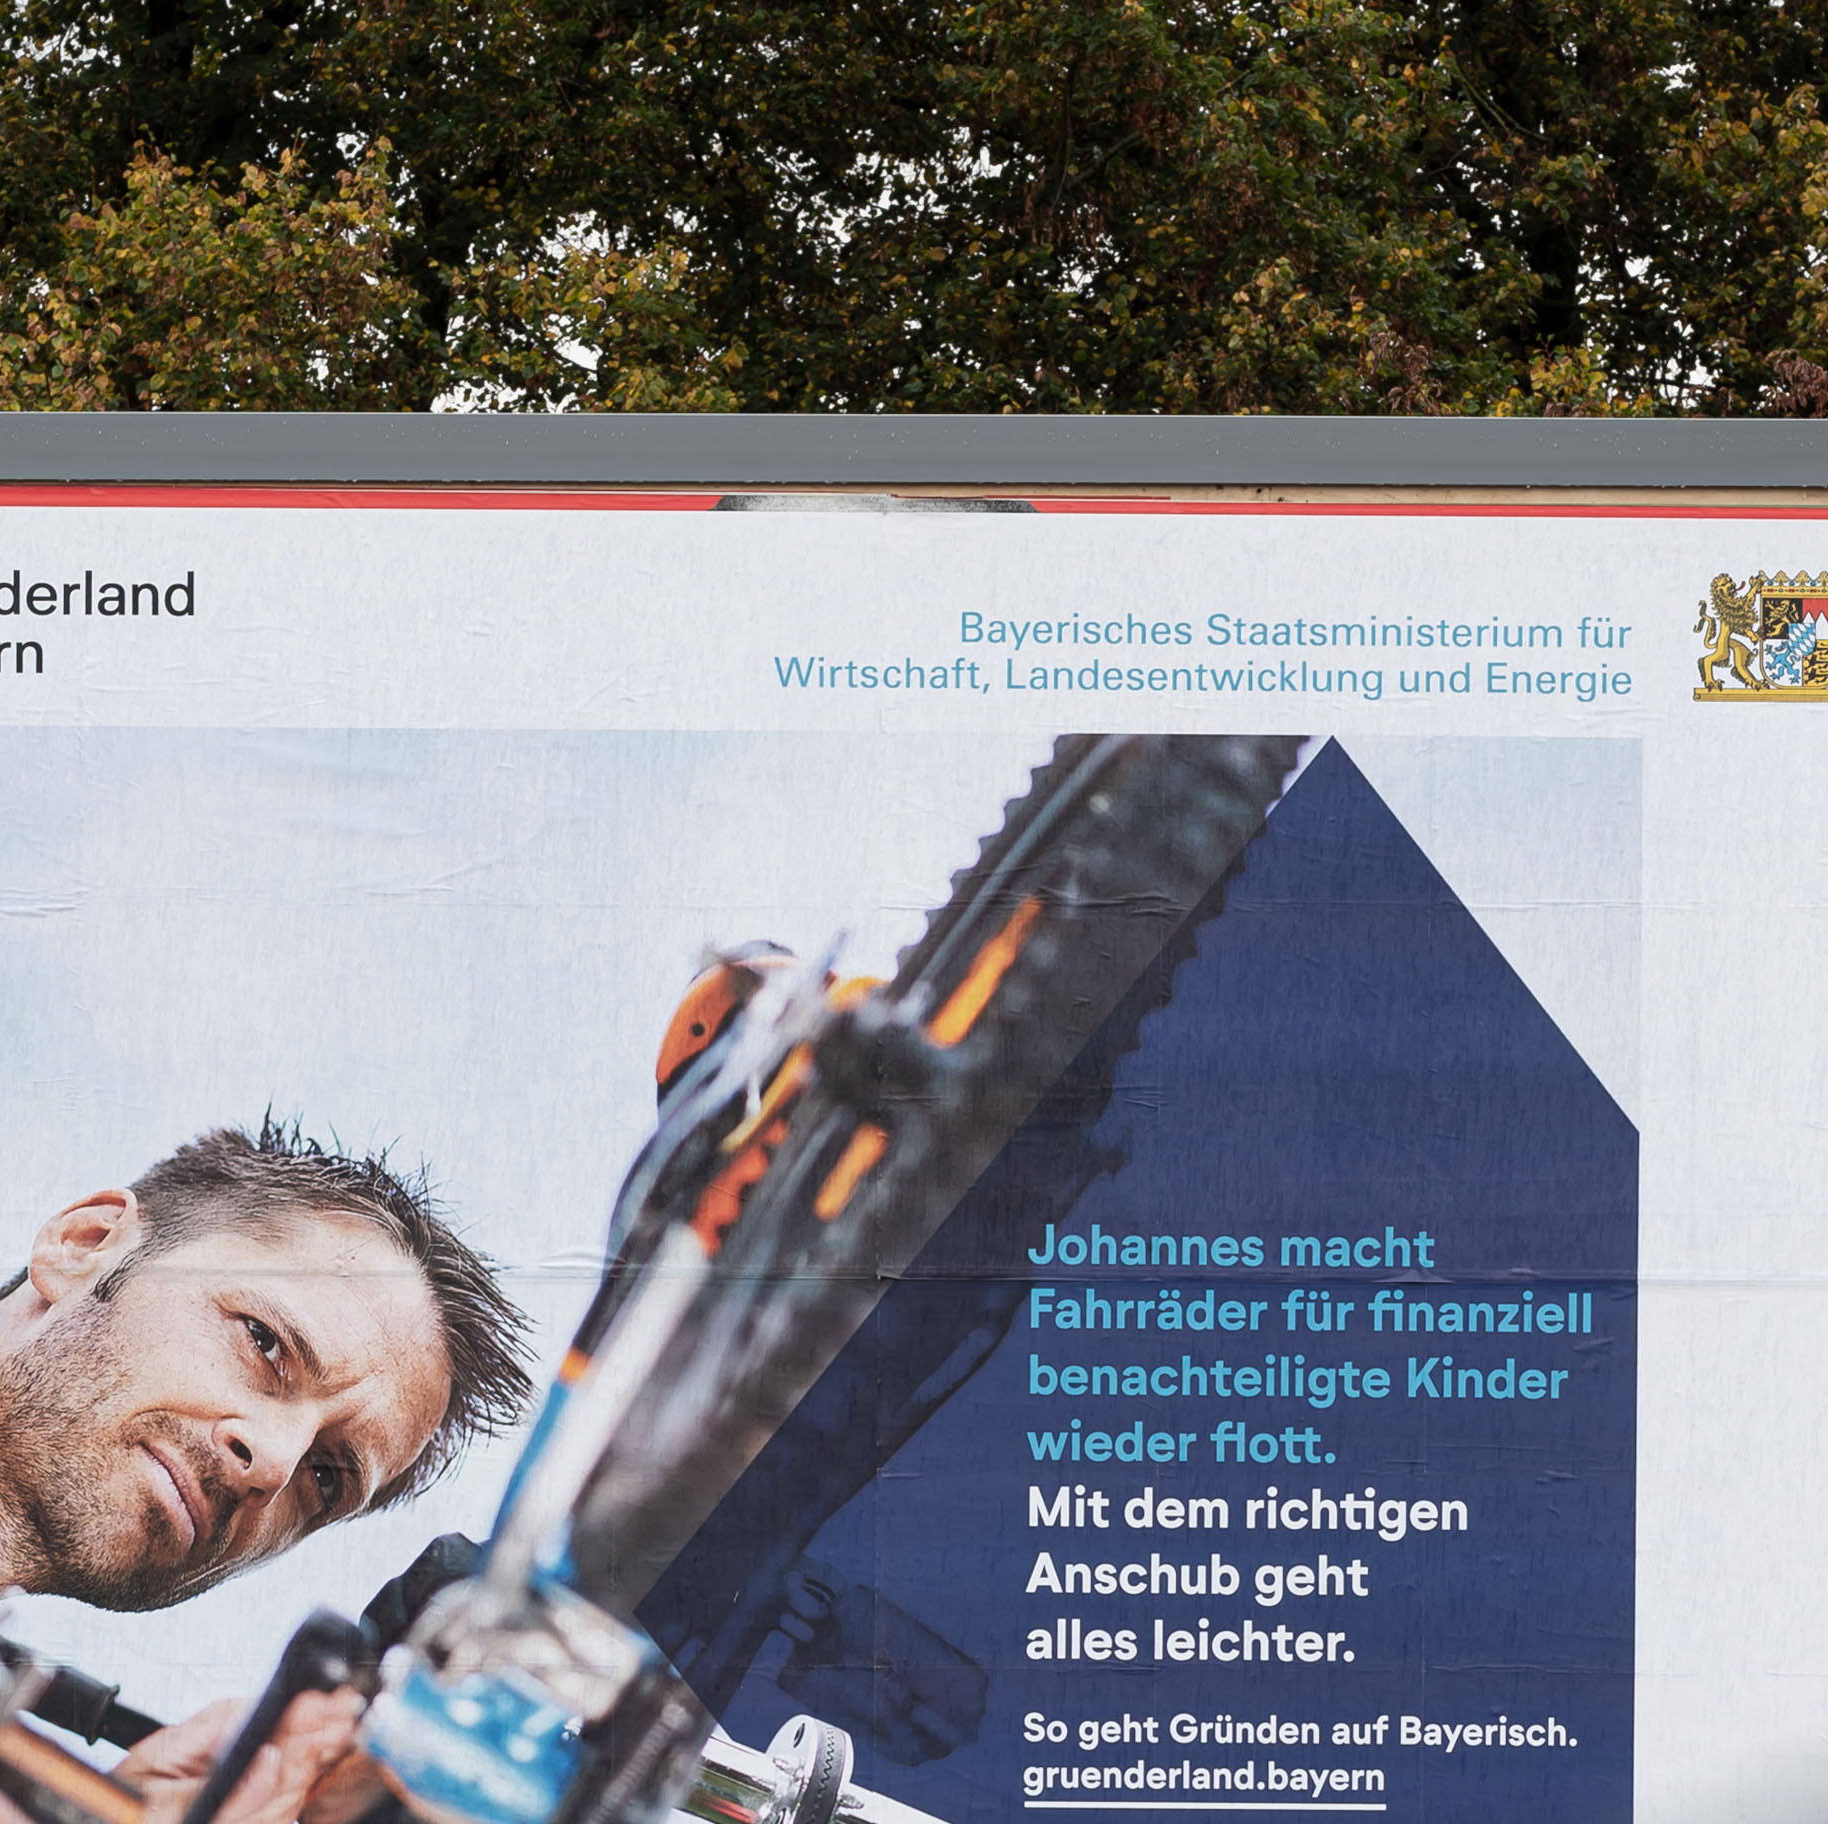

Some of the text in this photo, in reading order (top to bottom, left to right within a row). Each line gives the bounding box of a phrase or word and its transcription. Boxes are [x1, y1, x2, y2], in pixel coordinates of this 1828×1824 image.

[961, 611, 1633, 651] Bayerisches Staatsministerium für
[774, 656, 1632, 703] Wirtschaft, Landesentwicklung und Energie
[1028, 1223, 1435, 1268] Johannes macht
[1030, 1287, 1592, 1334] Fahrräder für finanziell
[1029, 1353, 1569, 1409] benachteiligte Kinder
[1026, 1418, 1336, 1464] wieder flott.
[1028, 1484, 1468, 1542] Mit dem richtigen
[1025, 1551, 1369, 1607] Anschub geht
[1026, 1617, 1355, 1663] alles leichter.
[1023, 1711, 1578, 1753] So geht Gründen auf Bayerisch.
[1023, 1759, 1385, 1798] gruenderland.bayern
